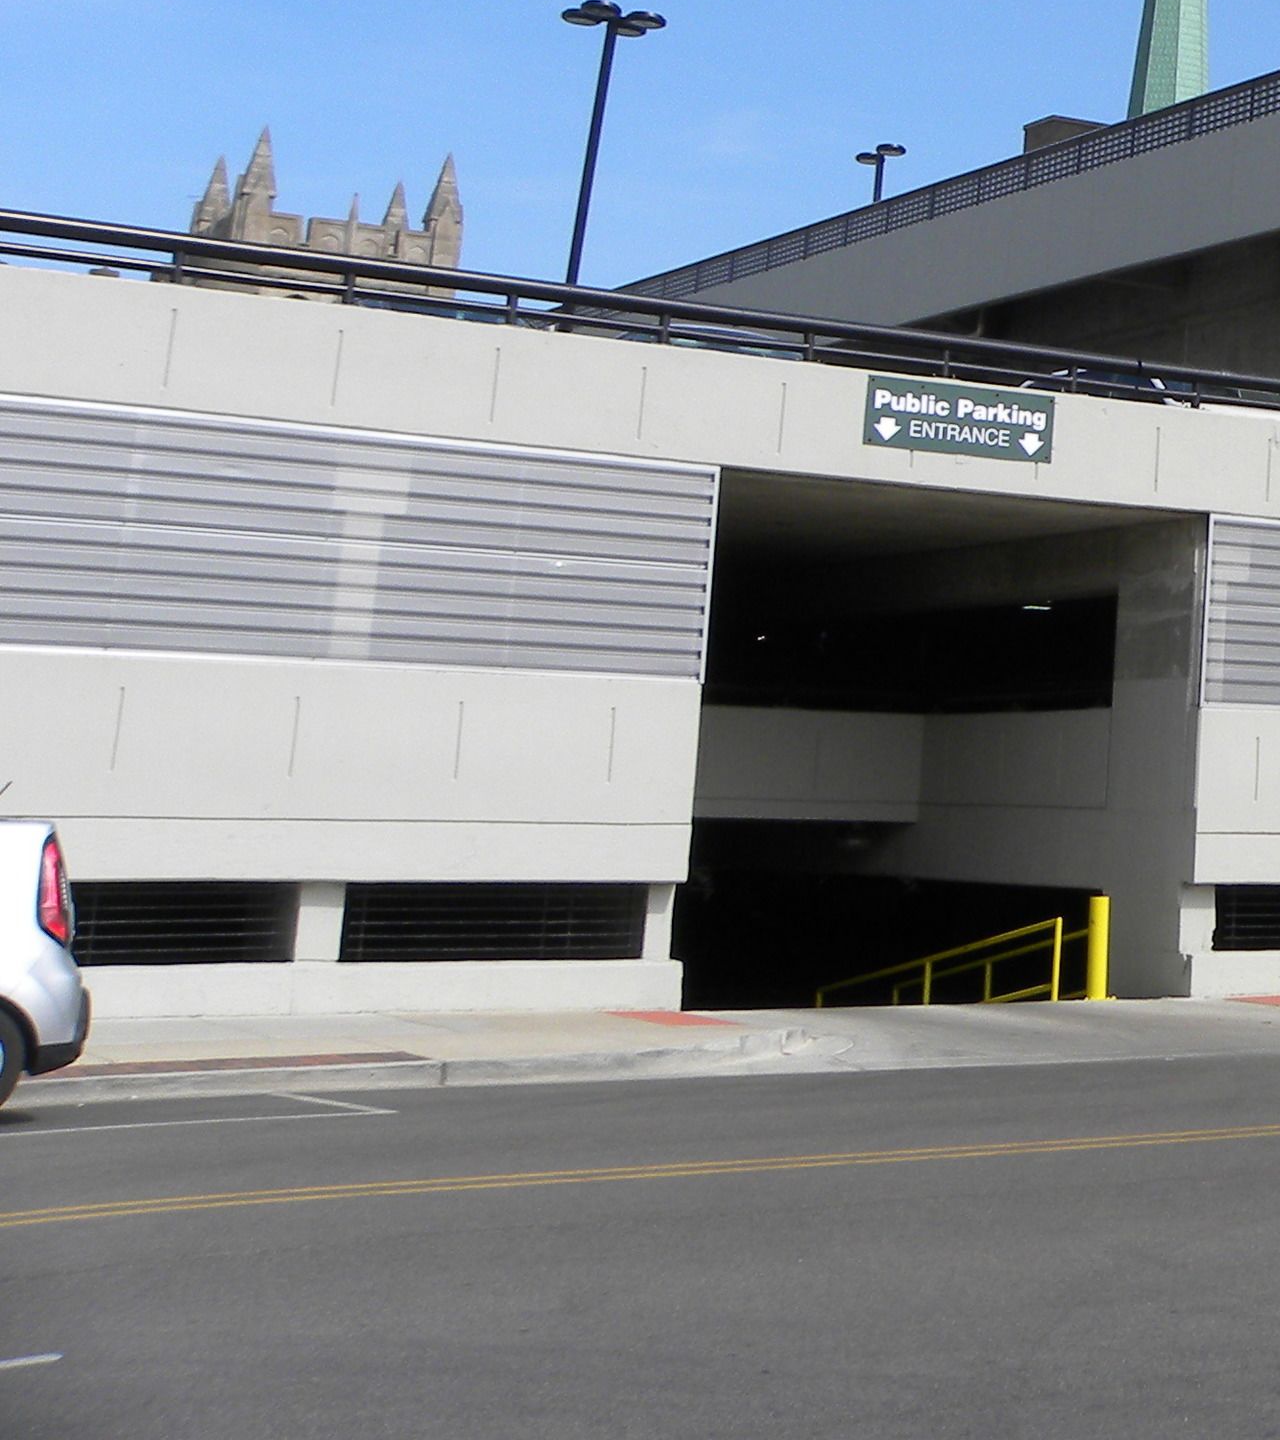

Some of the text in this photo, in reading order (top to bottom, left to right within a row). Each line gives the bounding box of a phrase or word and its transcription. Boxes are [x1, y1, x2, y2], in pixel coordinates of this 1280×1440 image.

[874, 389, 1046, 430] Public Parking
[910, 420, 1010, 447] ENTRANCE
